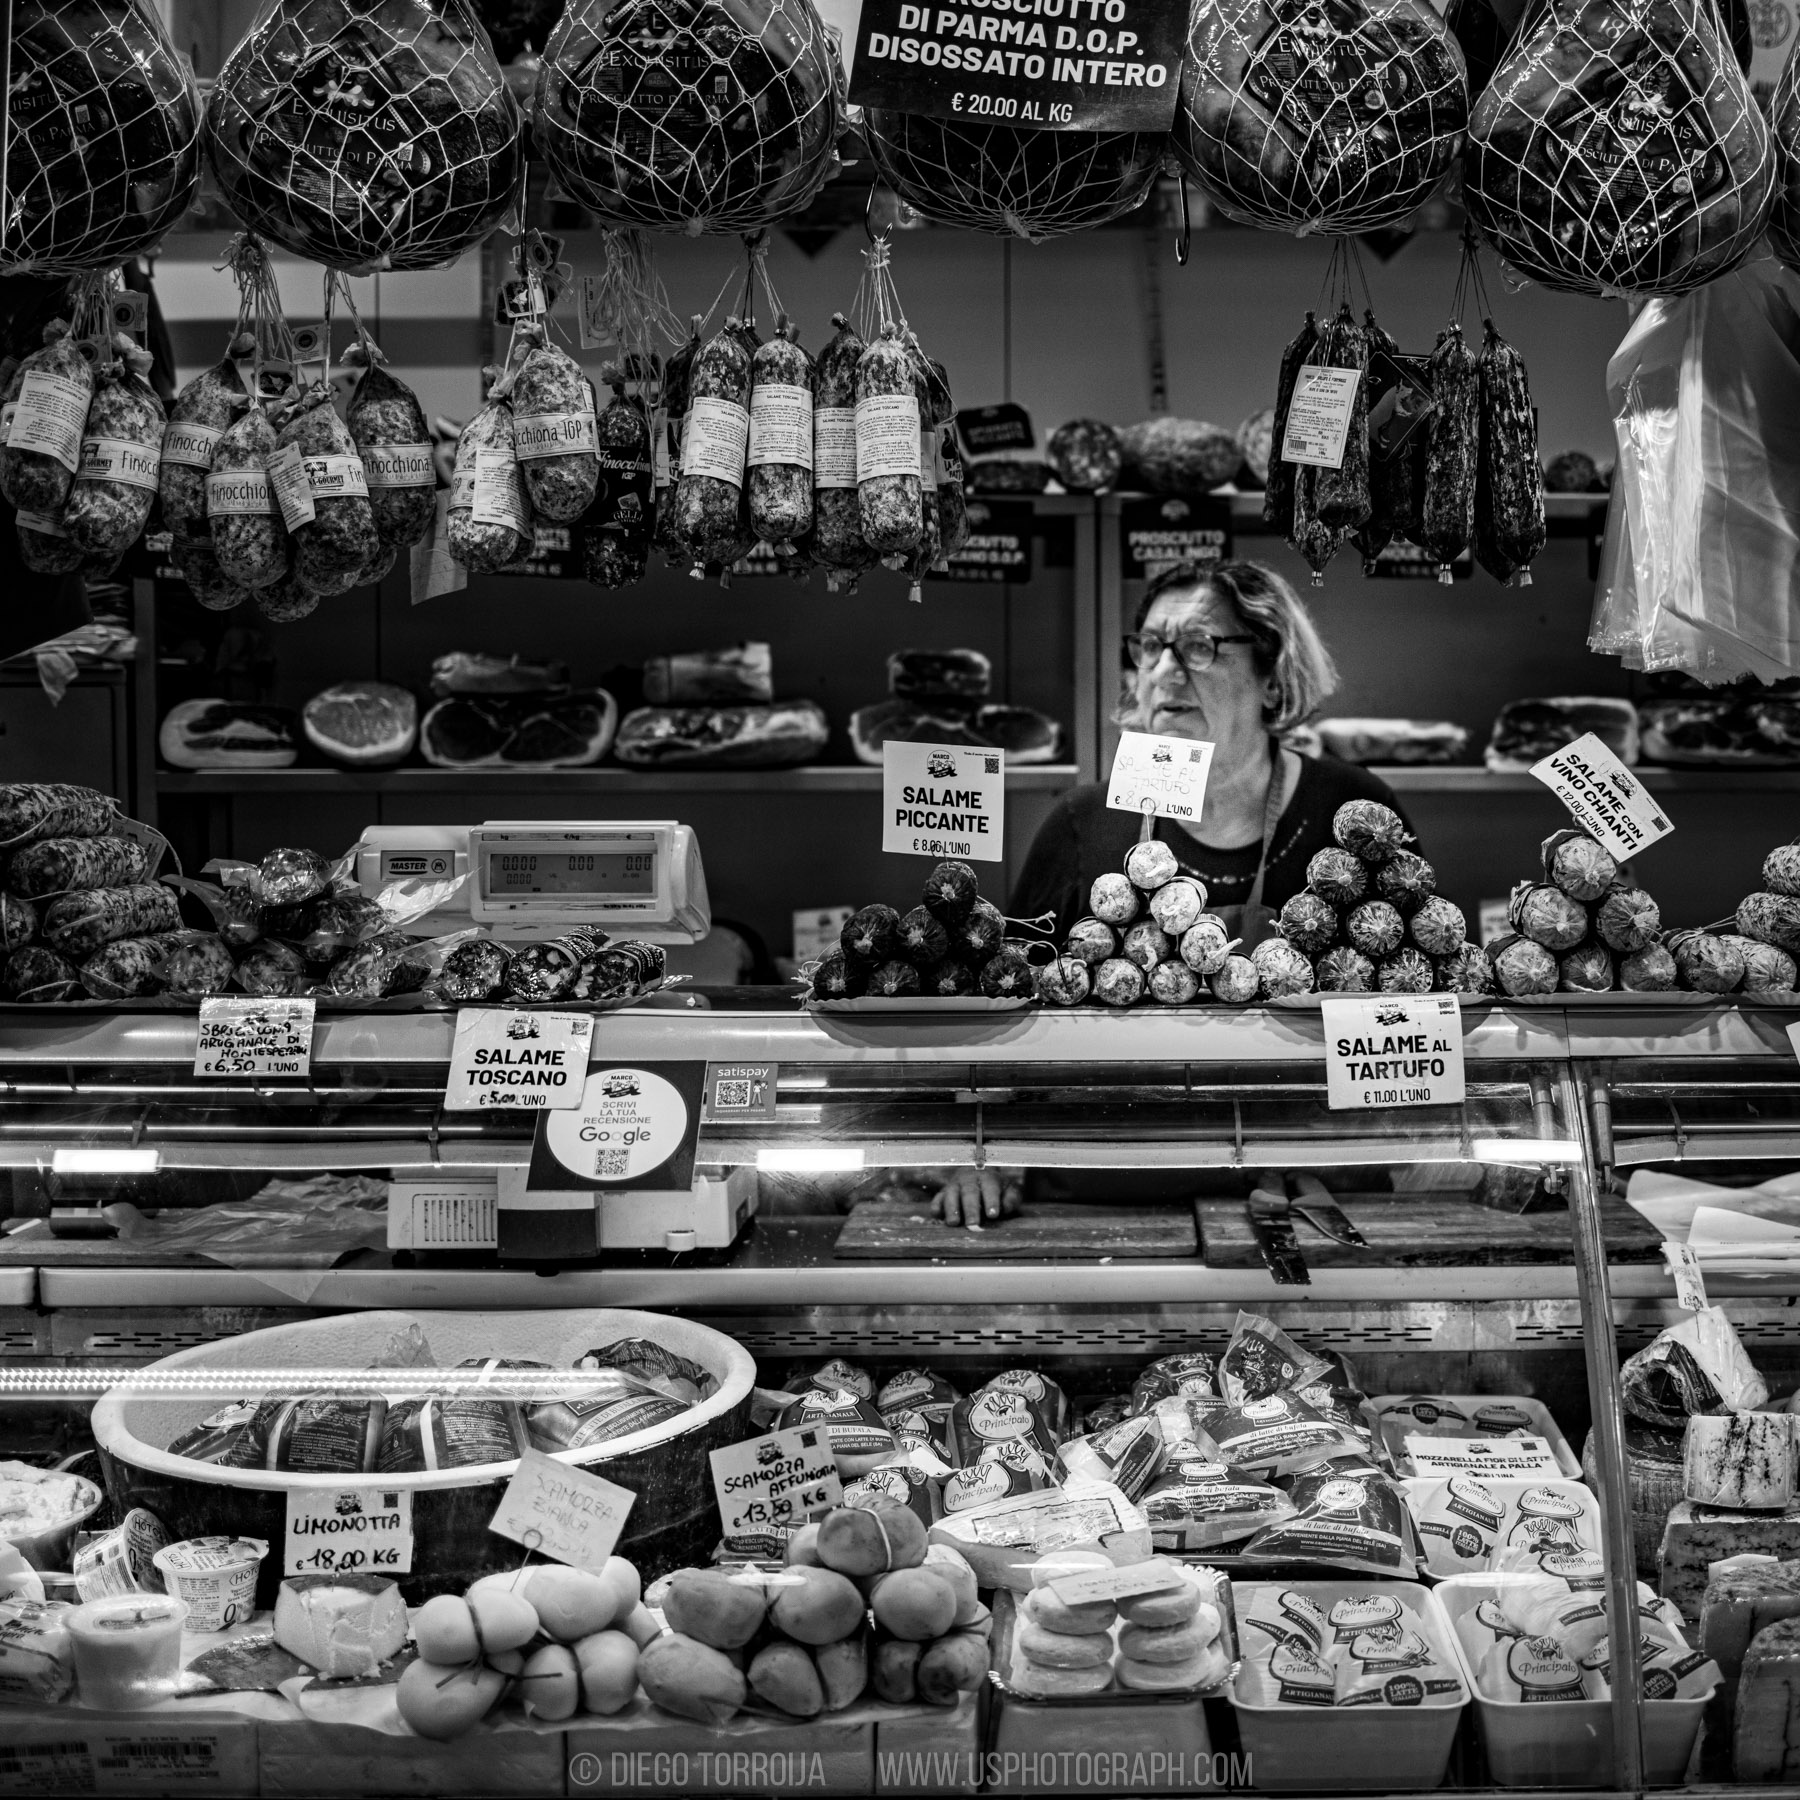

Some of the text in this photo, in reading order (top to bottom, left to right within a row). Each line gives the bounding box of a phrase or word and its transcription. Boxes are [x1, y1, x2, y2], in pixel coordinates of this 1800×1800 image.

[956, 0, 1126, 23] SCIUTTO
[898, 4, 1144, 57] DI PARMA D.O.P.
[868, 32, 1168, 88] DISOSSATO INTERO
[951, 92, 1073, 123] € 20.00 AL KG
[563, 420, 582, 440] IGP
[1118, 756, 1173, 778] SALME
[903, 786, 982, 810] SALAME
[1550, 758, 1639, 851] VINO CHIANTI
[1556, 785, 1566, 793] €
[1562, 791, 1586, 815] 12.00
[1566, 754, 1644, 840] SALAME CON
[1166, 803, 1193, 817] L'UNO
[896, 808, 989, 834] PICCANTE
[913, 838, 919, 851] €
[944, 841, 971, 856] L'UNO
[390, 861, 427, 872] MASTER
[287, 1032, 300, 1044] DI
[1337, 1035, 1452, 1057] SALAME AL
[204, 1058, 299, 1074] € 6,50 L'UNO
[474, 1049, 566, 1066] SALAME
[466, 1069, 568, 1087] TOSCANO
[717, 1067, 769, 1079] satispay
[1346, 1058, 1445, 1081] TARTUFO
[479, 1094, 487, 1106] €
[1364, 1088, 1431, 1104] € 11.00 L'UNO
[599, 1109, 637, 1117] LA TUA
[602, 1101, 637, 1110] SCRIVI
[583, 1116, 652, 1125] RECENSIONE
[579, 1126, 652, 1146] Google
[979, 1415, 1030, 1431] Principato
[1416, 1454, 1483, 1463] MOZZARELLA
[1431, 1461, 1497, 1469] ARTIGIANALE
[724, 1457, 805, 1494] SCAMORZA
[769, 1464, 837, 1498] AFFUMICATA
[950, 1486, 1003, 1506] Principato
[1455, 1483, 1500, 1511] Principato
[1525, 1496, 1575, 1512] Principato
[732, 1517, 741, 1528] €
[802, 1487, 827, 1508] KG
[1452, 1502, 1496, 1525] ARTIGIANALE
[293, 1513, 401, 1535] LIMONOTTA
[1303, 1521, 1311, 1529] di
[1314, 1522, 1332, 1531] latte
[1333, 1524, 1341, 1532] di
[1457, 1536, 1479, 1548] LATTE
[1458, 1529, 1480, 1543] 100%
[296, 1548, 400, 1572] € 18,00 KG
[1335, 1604, 1392, 1619] Principato
[1279, 1665, 1333, 1680] Principato
[1518, 1662, 1577, 1676] Principato
[1388, 1682, 1416, 1691] 100%
[1390, 1687, 1419, 1696] LATTE
[1525, 1690, 1582, 1702] ARTIGIANALE
